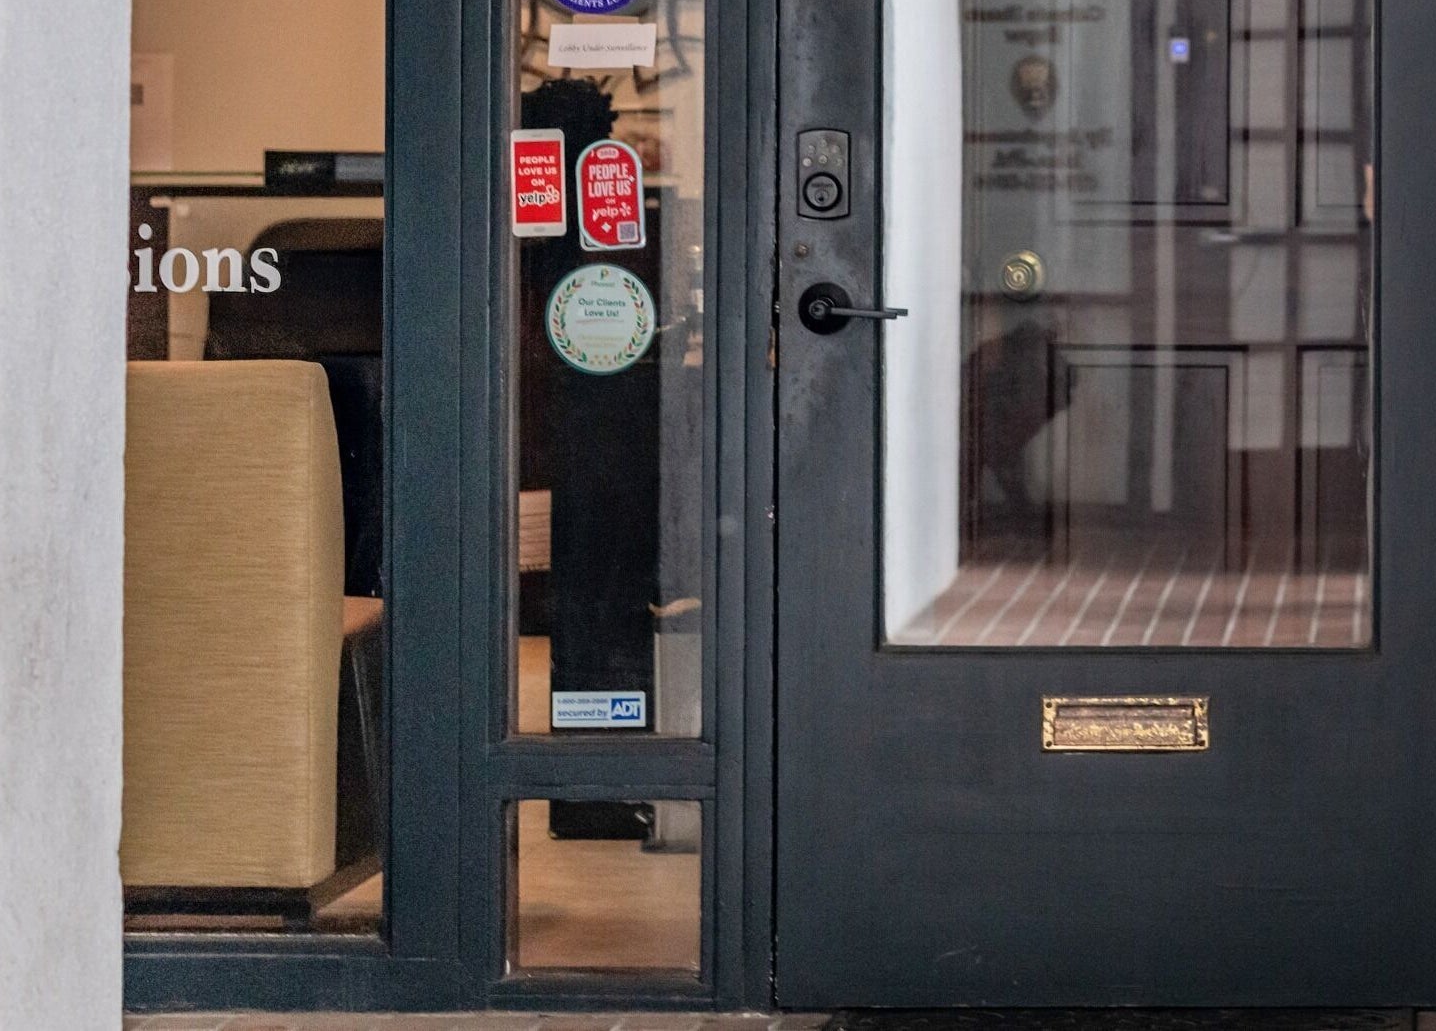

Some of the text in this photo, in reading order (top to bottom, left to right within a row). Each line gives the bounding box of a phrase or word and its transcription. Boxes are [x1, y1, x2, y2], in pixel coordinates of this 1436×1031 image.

[519, 155, 556, 165] PEOPLE
[518, 166, 557, 176] LOVE US
[588, 162, 629, 180] PEOPLE
[530, 178, 546, 187] ON
[588, 181, 632, 198] LOVE US
[519, 192, 546, 205] yelp
[592, 206, 619, 222] yelp
[128, 223, 282, 294] ions
[578, 298, 626, 307] Our Clients
[584, 309, 619, 317] Love Us!
[557, 708, 596, 717] secured
[597, 708, 608, 718] by
[611, 701, 641, 717] ADT
